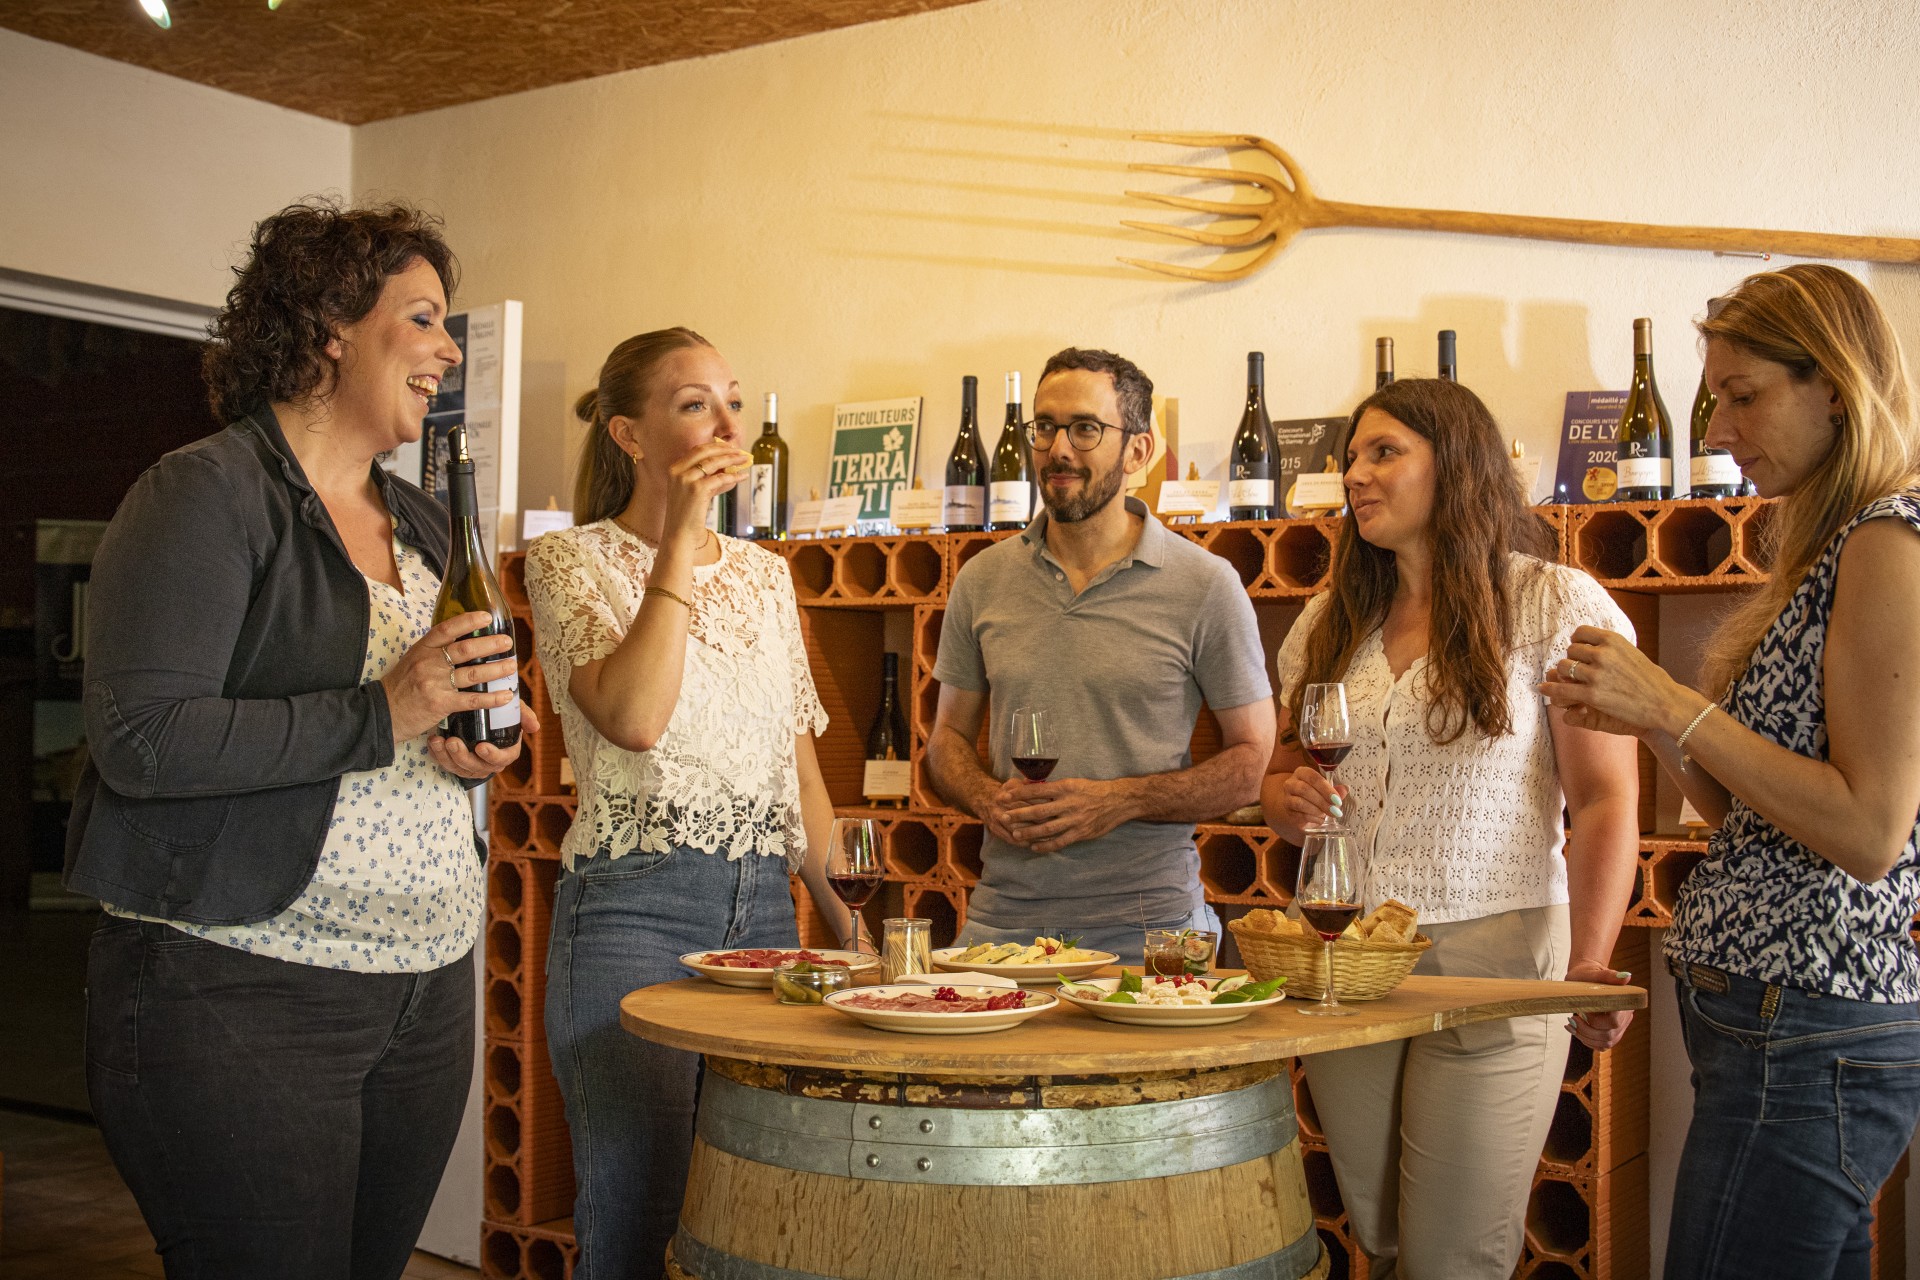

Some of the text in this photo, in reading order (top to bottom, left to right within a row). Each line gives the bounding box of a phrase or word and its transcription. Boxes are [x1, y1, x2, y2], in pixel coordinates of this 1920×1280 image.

[837, 408, 915, 427] VITICULTEURS
[1569, 425, 1619, 439] DE LY
[1280, 457, 1301, 470] 015
[1587, 451, 1617, 463] 2020
[834, 451, 906, 483] TERRA
